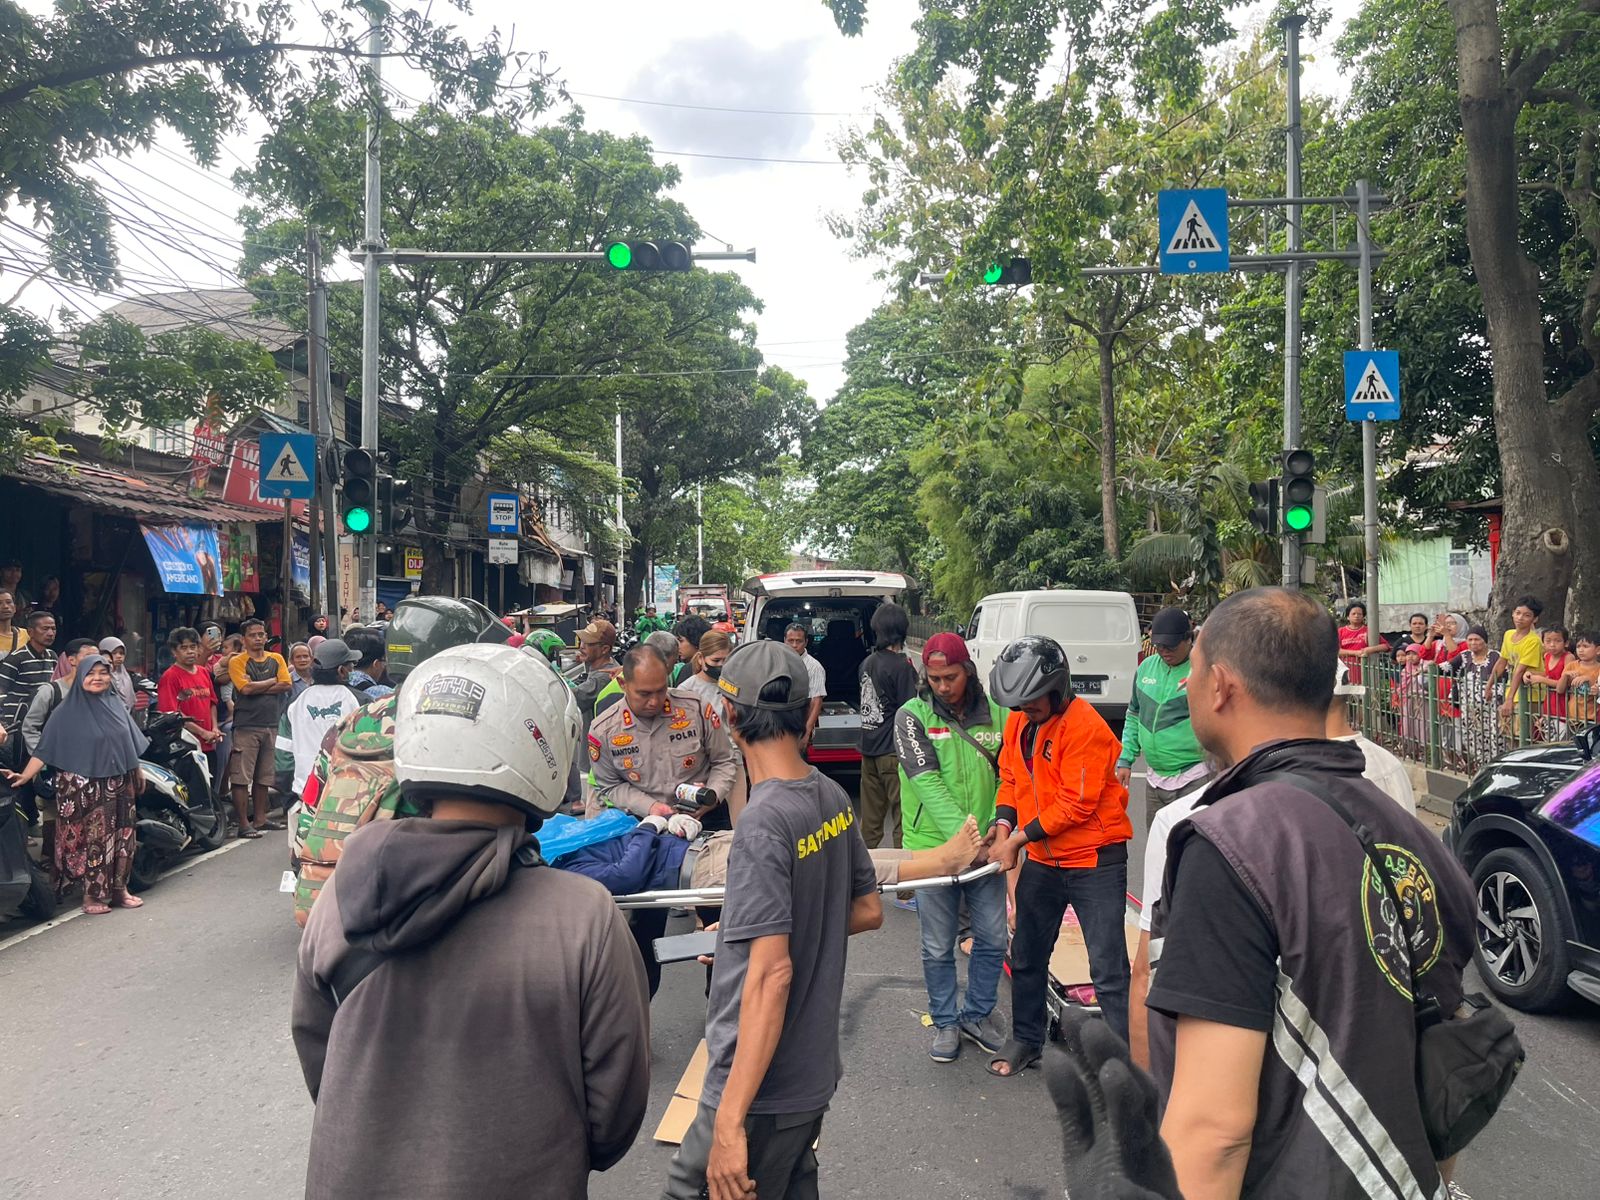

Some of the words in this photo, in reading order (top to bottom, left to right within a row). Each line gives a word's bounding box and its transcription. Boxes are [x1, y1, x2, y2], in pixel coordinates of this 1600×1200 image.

[1141, 677, 1157, 685] Grab
[669, 729, 697, 742] POLRI
[905, 715, 926, 767] tokopedia
[1371, 854, 1433, 903] GABBER
